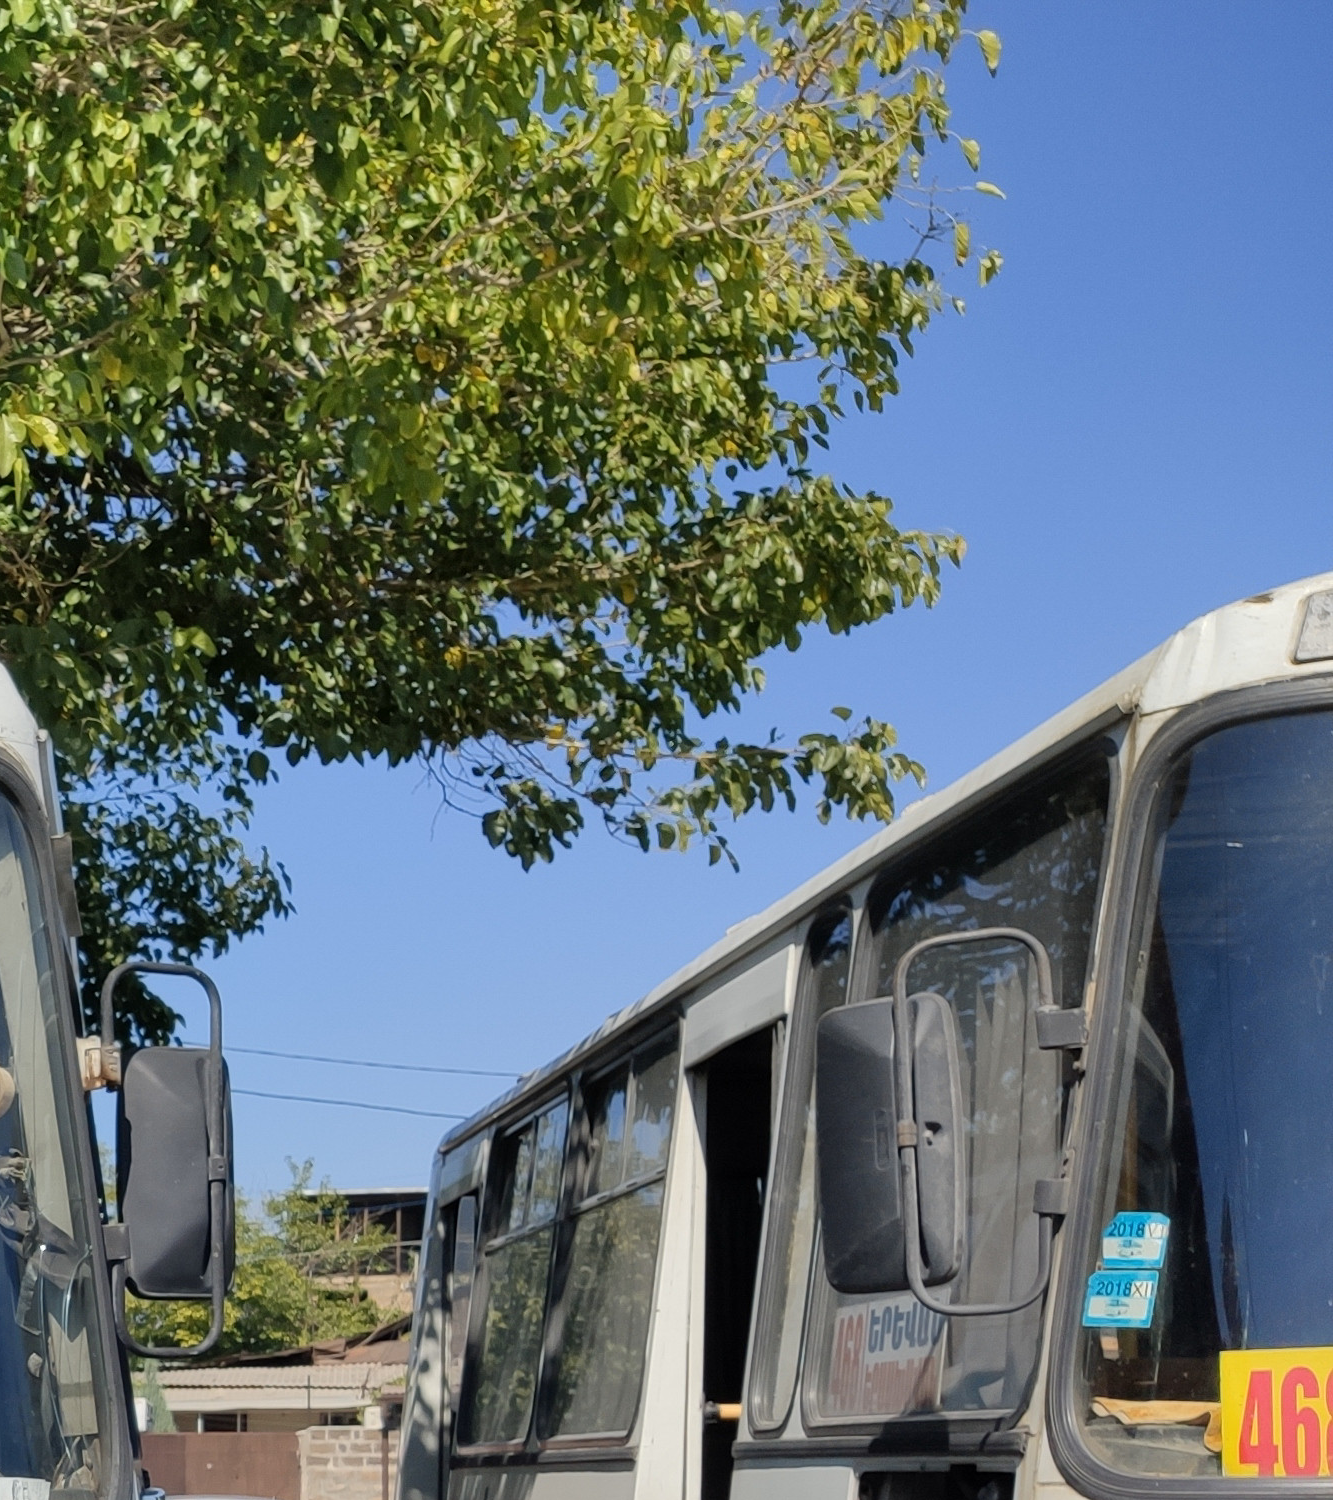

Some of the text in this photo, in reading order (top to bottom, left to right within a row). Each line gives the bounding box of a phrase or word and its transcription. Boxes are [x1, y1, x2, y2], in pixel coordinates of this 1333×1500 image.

[1108, 1221, 1145, 1238] 2018
[1096, 1280, 1133, 1297] 2018
[1238, 1366, 1333, 1477] 46
